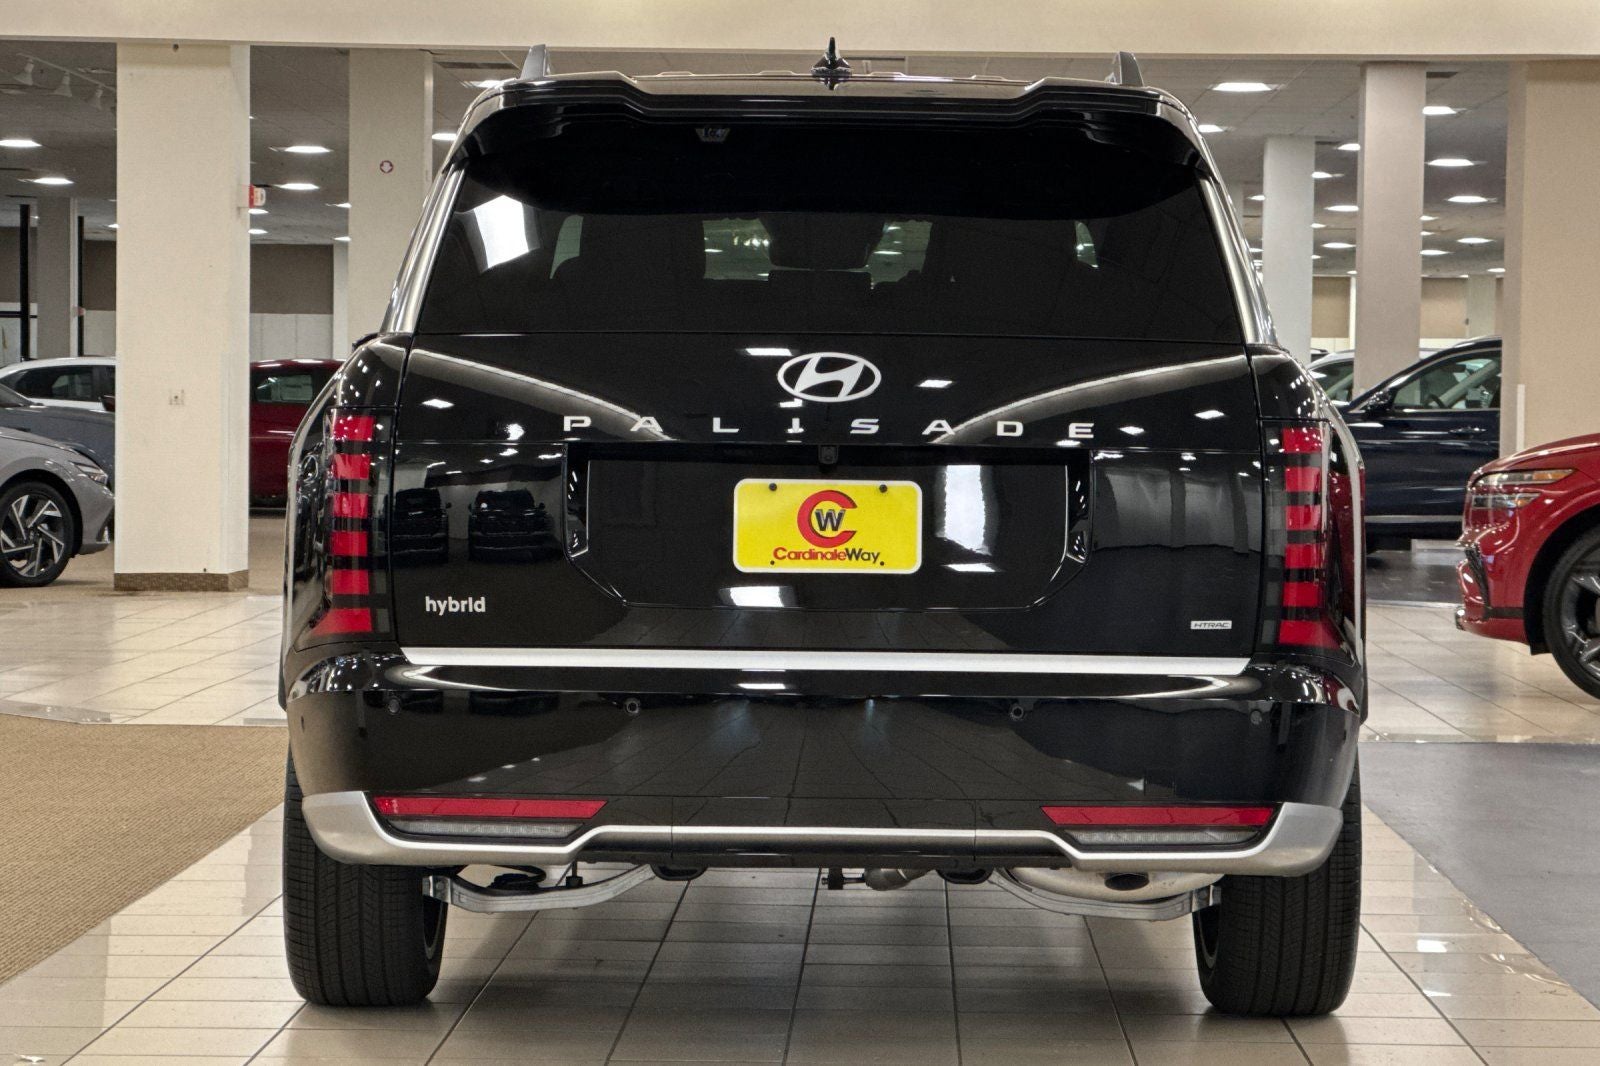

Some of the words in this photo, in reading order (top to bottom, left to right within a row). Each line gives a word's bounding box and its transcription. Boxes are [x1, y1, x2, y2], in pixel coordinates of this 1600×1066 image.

[563, 415, 1094, 438] PALISADE
[773, 547, 880, 563] CardinaleWay
[425, 595, 486, 616] hybrid
